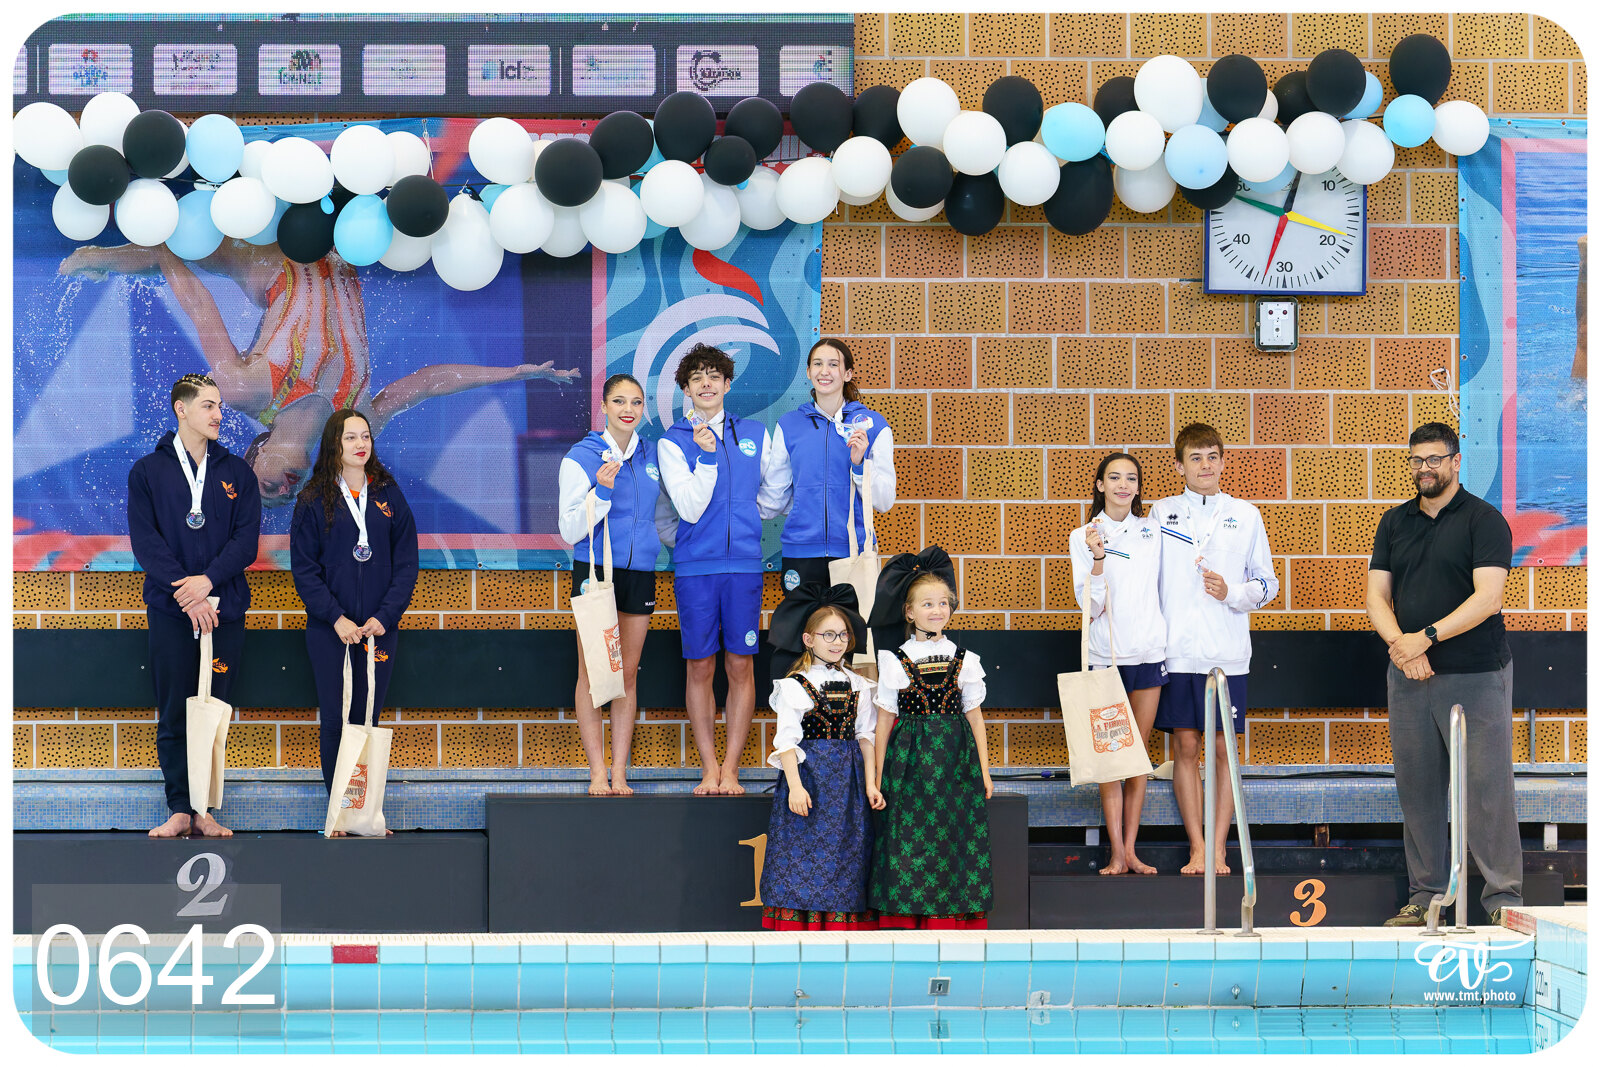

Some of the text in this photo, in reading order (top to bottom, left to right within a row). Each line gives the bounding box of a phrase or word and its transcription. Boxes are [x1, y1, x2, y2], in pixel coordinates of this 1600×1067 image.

[1321, 180, 1336, 191] 10
[1232, 233, 1250, 245] 40
[1319, 234, 1336, 246] 20
[1276, 261, 1293, 273] 30
[738, 833, 768, 907] 1
[176, 852, 229, 917] 2
[1289, 878, 1327, 927] 3
